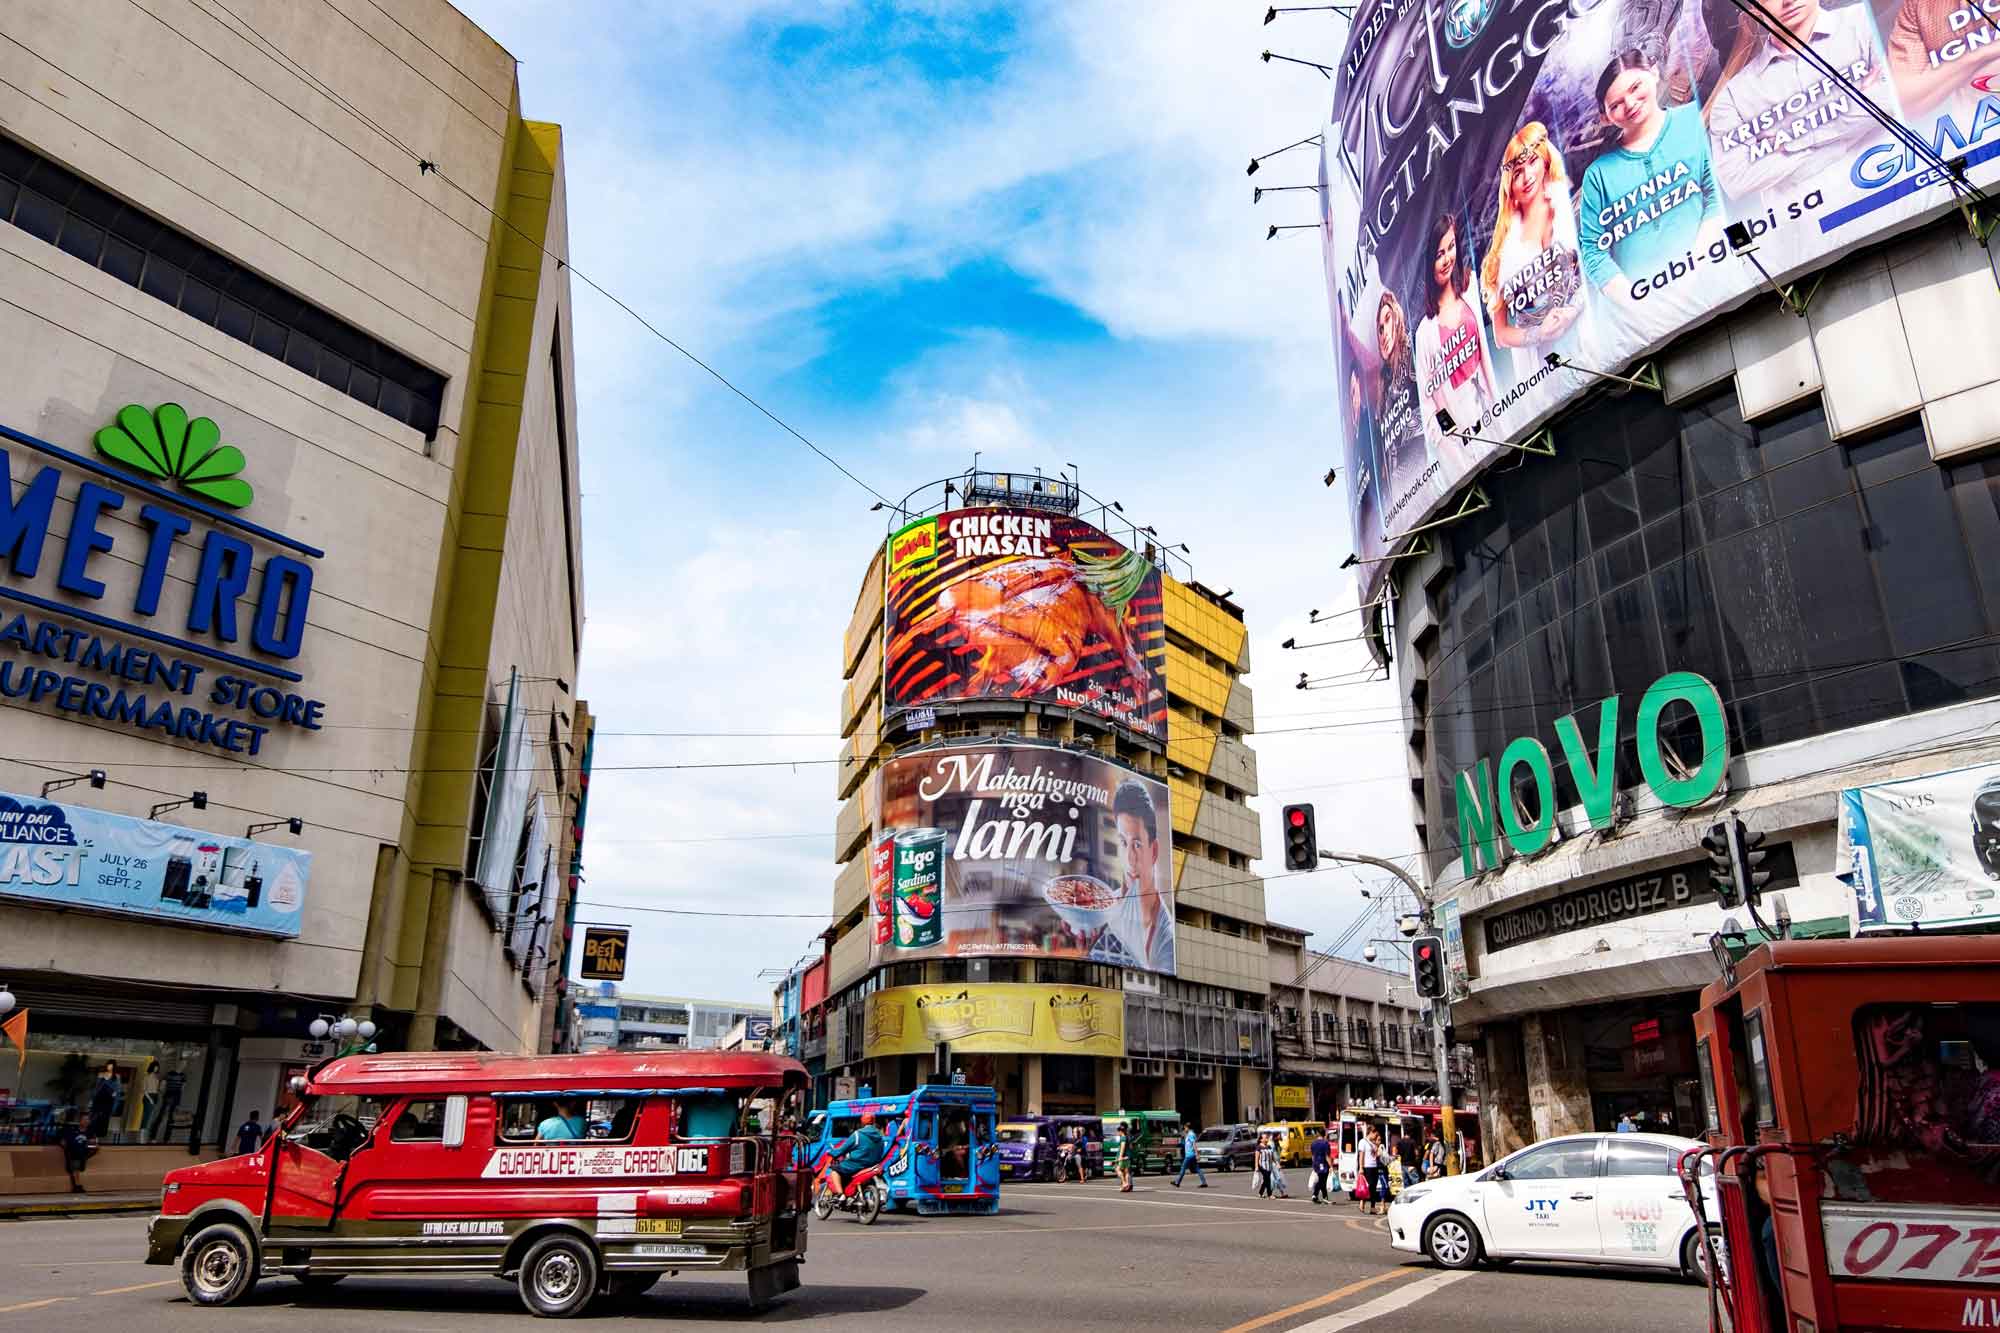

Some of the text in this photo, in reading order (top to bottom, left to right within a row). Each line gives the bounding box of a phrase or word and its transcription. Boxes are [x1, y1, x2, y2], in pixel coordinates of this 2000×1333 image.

[1928, 24, 2000, 69] IGN
[1721, 59, 1868, 152] KRISTOFFER
[1751, 96, 1851, 162] MARTIN
[1596, 179, 1701, 251] ORTALEZA
[1598, 160, 1691, 226] CHYNNA
[1630, 188, 1824, 301] Gabi-gbi sa
[1503, 242, 1564, 301] ANDREA
[1507, 264, 1563, 317] TORRES
[1425, 335, 1478, 397] GUTIERREZ
[1381, 389, 1410, 438] PANCHO
[949, 515, 1052, 540] CHICKEN
[955, 535, 1046, 558] INASAL
[0, 449, 314, 660] METRO
[0, 612, 326, 731] ARTMENT STORE
[919, 753, 1110, 806] Makahigugma
[1454, 671, 1731, 879] NOVO
[0, 812, 24, 823] INY
[999, 791, 1045, 818] nga
[952, 799, 1080, 863] lami
[97, 873, 143, 890] SEPT. 2
[100, 852, 148, 870] JULY 26
[116, 866, 128, 877] to
[897, 871, 937, 890] Sardines
[900, 850, 935, 871] Ligo
[1492, 908, 1547, 944] QUIRINO
[1551, 877, 1665, 928] RODRIGUEZ
[1671, 872, 1690, 901] B
[585, 938, 625, 958] BEST
[596, 957, 624, 973] INN
[499, 1151, 577, 1175] GUADALUPE
[623, 1150, 676, 1174] CARBON
[1525, 1199, 1560, 1211] JTY
[1535, 1212, 1550, 1220] TAXI
